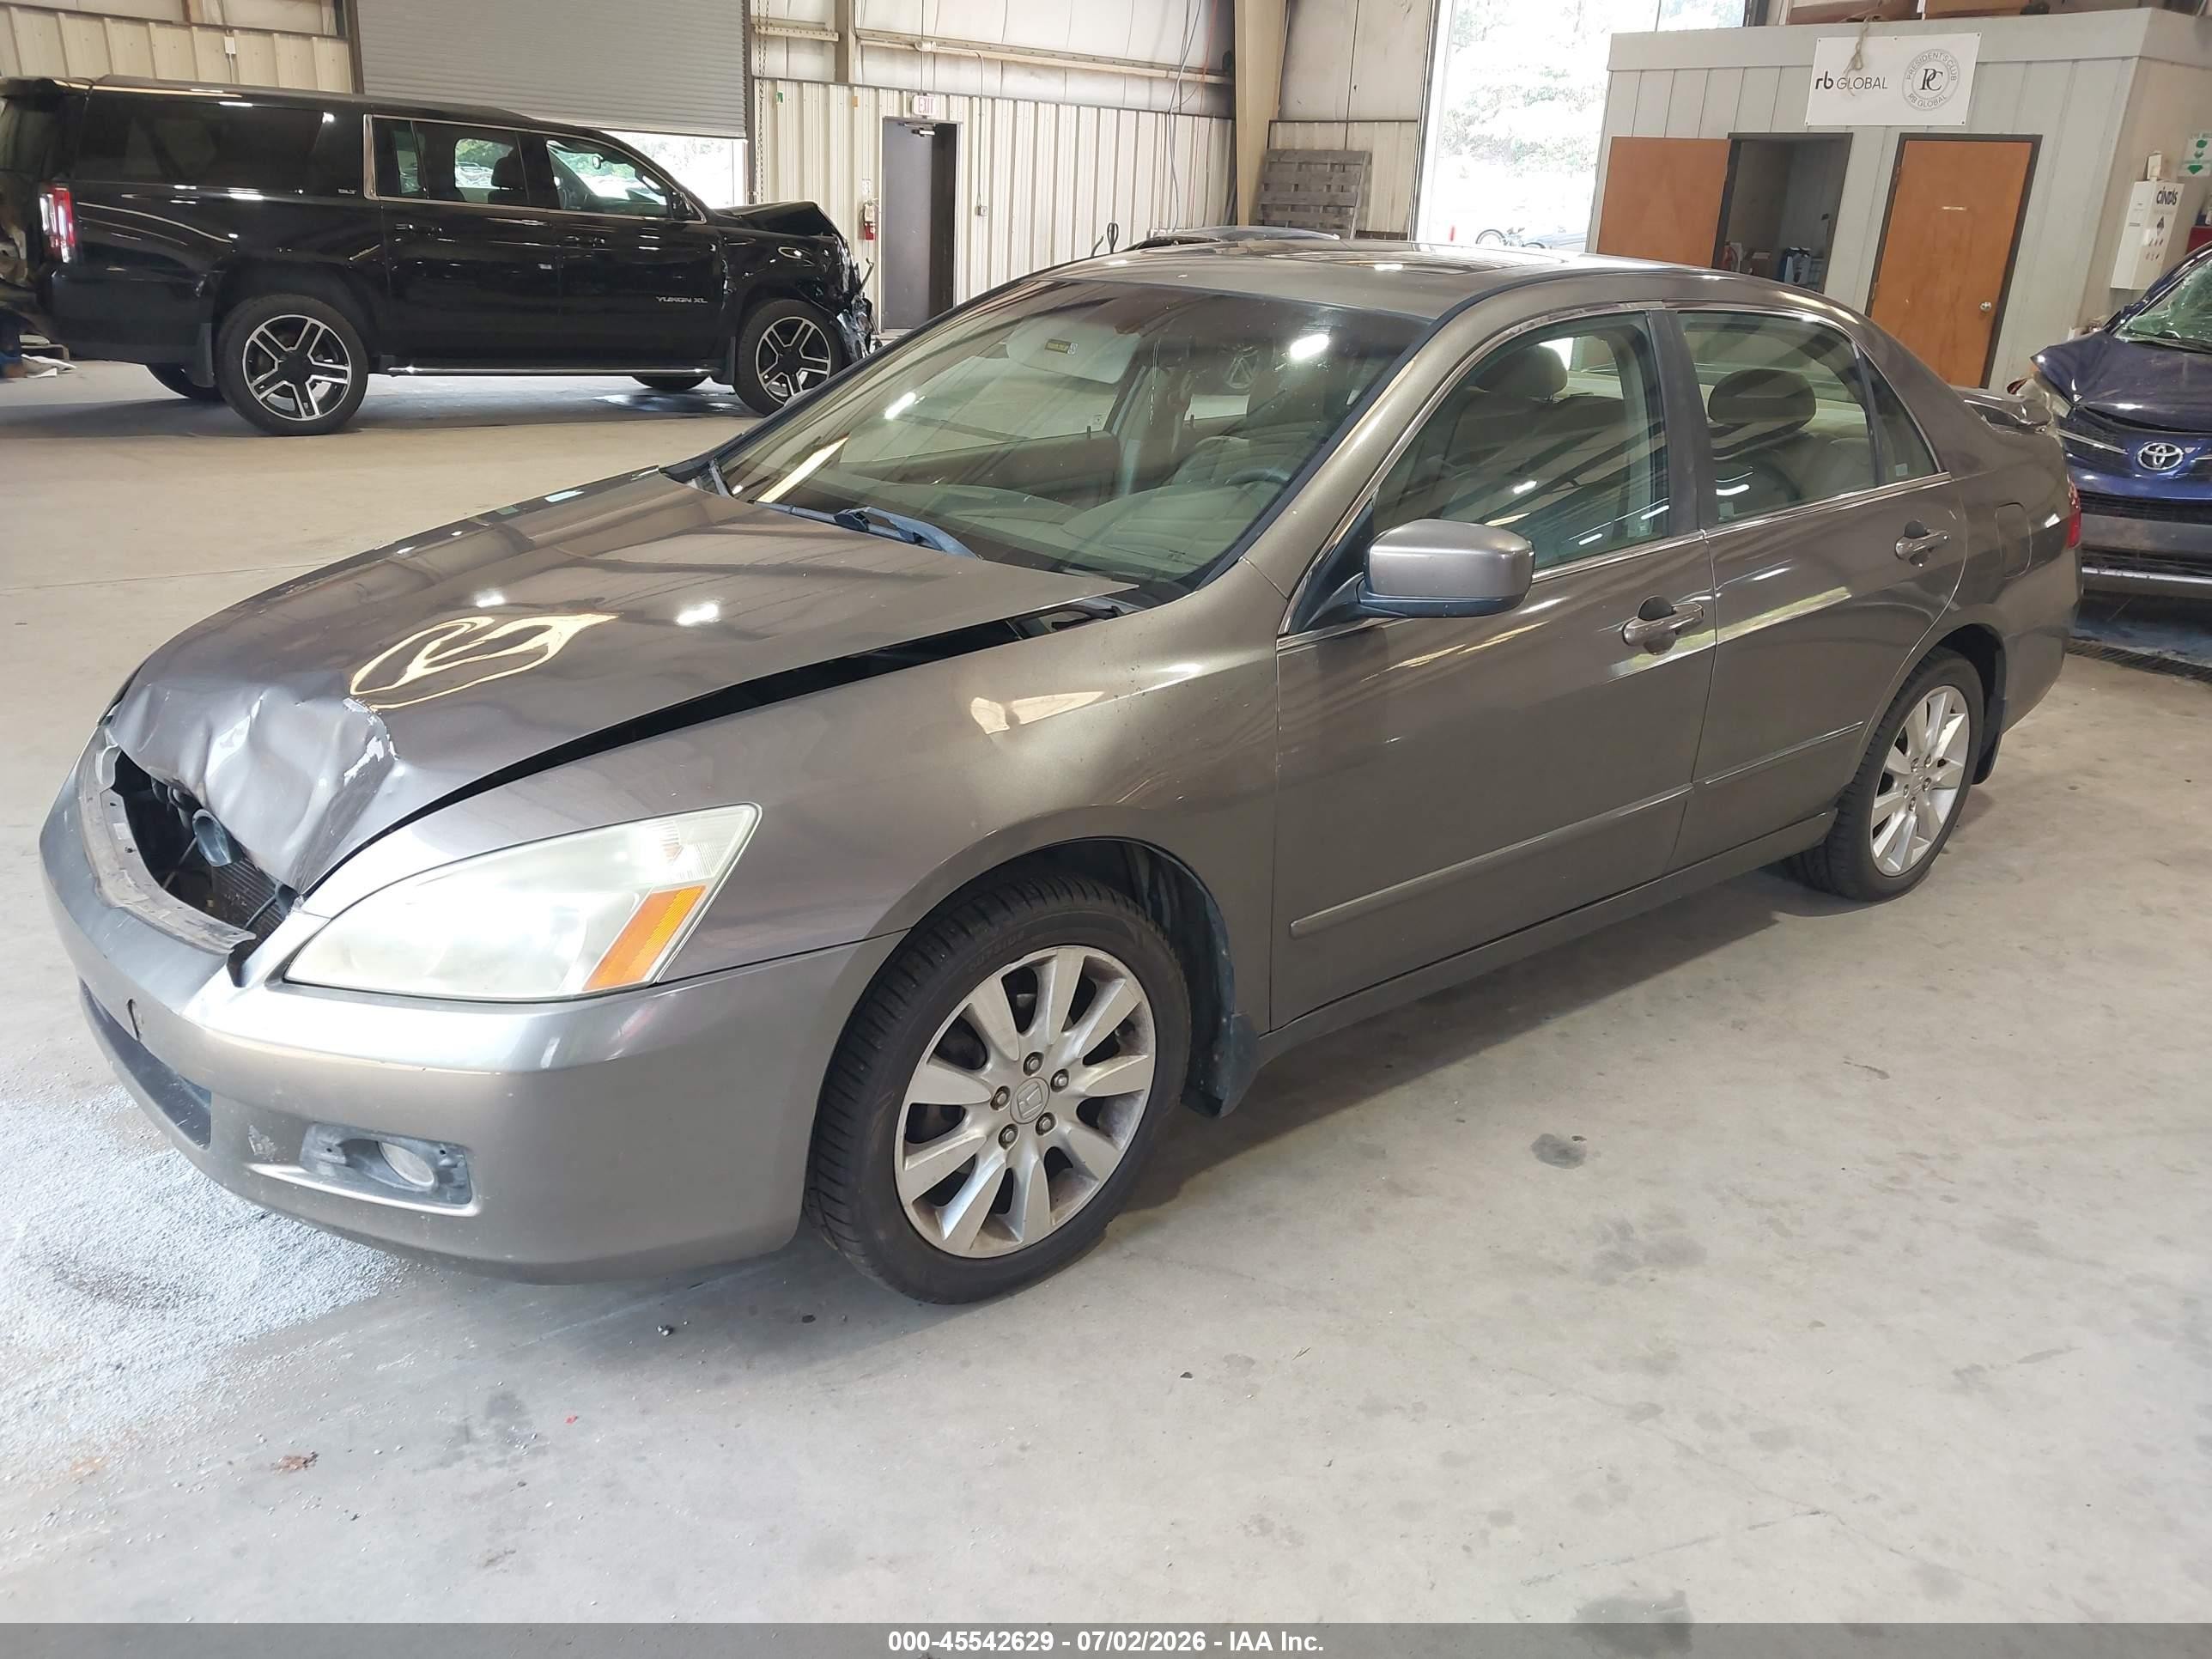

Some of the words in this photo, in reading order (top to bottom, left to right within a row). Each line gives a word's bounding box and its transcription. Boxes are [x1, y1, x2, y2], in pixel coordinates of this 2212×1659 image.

[1815, 70, 1834, 90] rb
[1836, 76, 1888, 90] GLOBAL
[918, 96, 934, 114] EXIT
[1907, 93, 1917, 104] RB
[1917, 94, 1947, 107] GLOBAL
